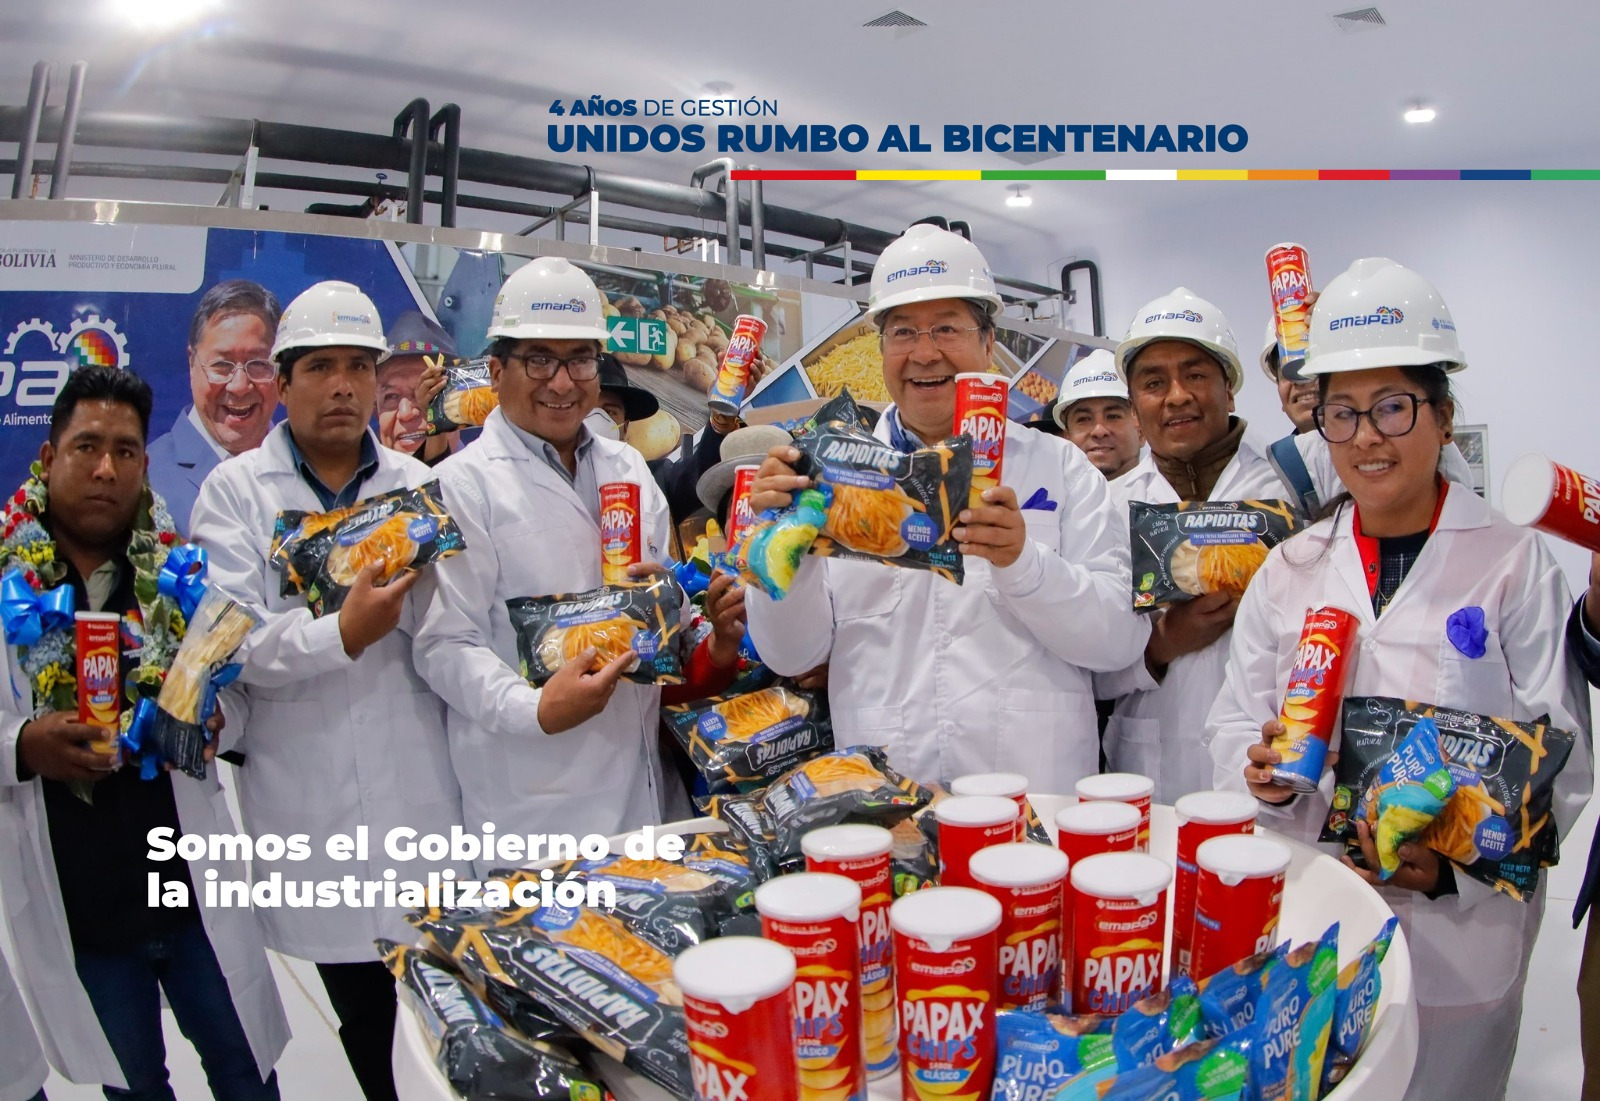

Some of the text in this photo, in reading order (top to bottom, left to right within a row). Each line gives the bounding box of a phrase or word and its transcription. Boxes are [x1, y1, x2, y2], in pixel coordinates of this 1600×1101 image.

[68, 261, 110, 269] PRODUCTIVO
[69, 254, 106, 262] MINISTERIO
[117, 255, 159, 263] DESARROLLO
[887, 264, 942, 283] emapa
[531, 302, 581, 313] emapa
[1145, 312, 1197, 325] emapa
[1329, 314, 1395, 332] emapa
[822, 440, 901, 469] RAPIDITAS
[601, 509, 634, 531] PAPAX
[1185, 513, 1259, 528] RAPIDITAS
[907, 524, 931, 535] MENOS
[907, 532, 931, 543] ACEITE
[554, 592, 624, 617] RAPIDITAS
[83, 655, 118, 681] PAPAX
[756, 728, 812, 766] RAPIDITAS
[1402, 744, 1426, 777] PURO
[1482, 828, 1507, 843] MENOS
[1480, 840, 1505, 852] ACEITE
[1515, 864, 1531, 874] NETO
[1098, 919, 1151, 932] emapa
[911, 962, 966, 976] emapa
[1083, 952, 1161, 999] PAPAX
[521, 946, 651, 1030] RAPIDITAS
[902, 1000, 986, 1047] PAPAX
[1338, 999, 1373, 1047] PURÉ
[907, 1033, 978, 1062] CHIPS
[1262, 1018, 1302, 1070] PURÉ
[922, 1069, 961, 1081] CLÁSICO
[1001, 1054, 1064, 1085] PURO
